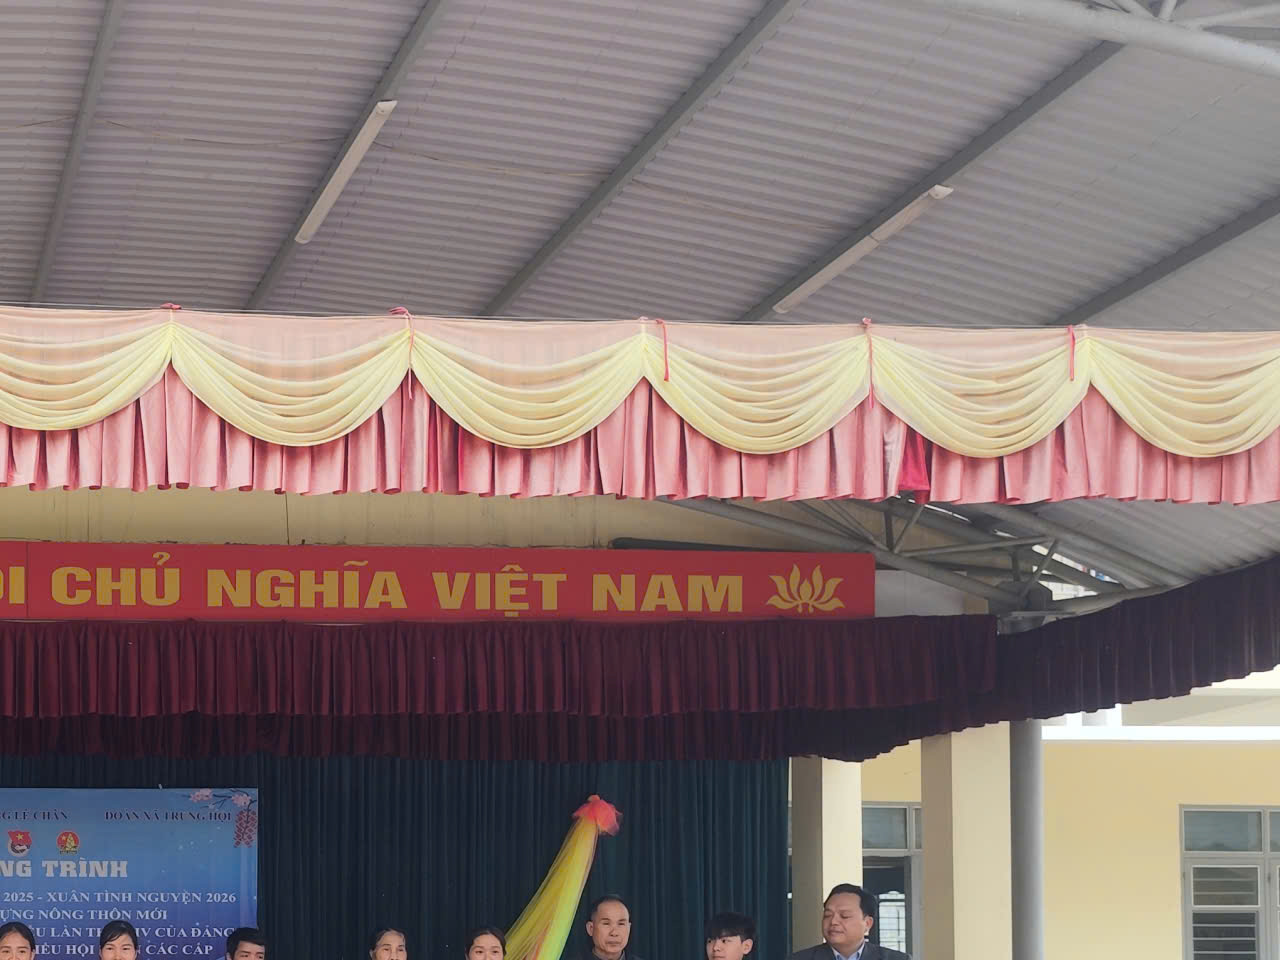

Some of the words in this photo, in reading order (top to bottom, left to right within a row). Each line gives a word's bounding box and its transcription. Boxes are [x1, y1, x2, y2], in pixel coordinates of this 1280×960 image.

[51, 552, 179, 606] CHỦ
[207, 561, 408, 610] NGHĨA
[432, 564, 566, 618] VIỆT
[592, 574, 743, 613] NAM
[163, 811, 205, 821] TRUNG
[42, 857, 128, 878] TRÌNH
[4, 891, 34, 902] 2025
[47, 890, 89, 902] XUÂN
[94, 890, 132, 902] TÌNH
[137, 889, 202, 905] NGUYỆN
[206, 892, 236, 903] 2026
[39, 906, 83, 920] NÔNG
[87, 906, 131, 920] THÔN
[136, 907, 167, 920] MỚI
[155, 924, 187, 937] CỦA
[65, 943, 95, 957] HỘI
[145, 943, 177, 955] CÁC
